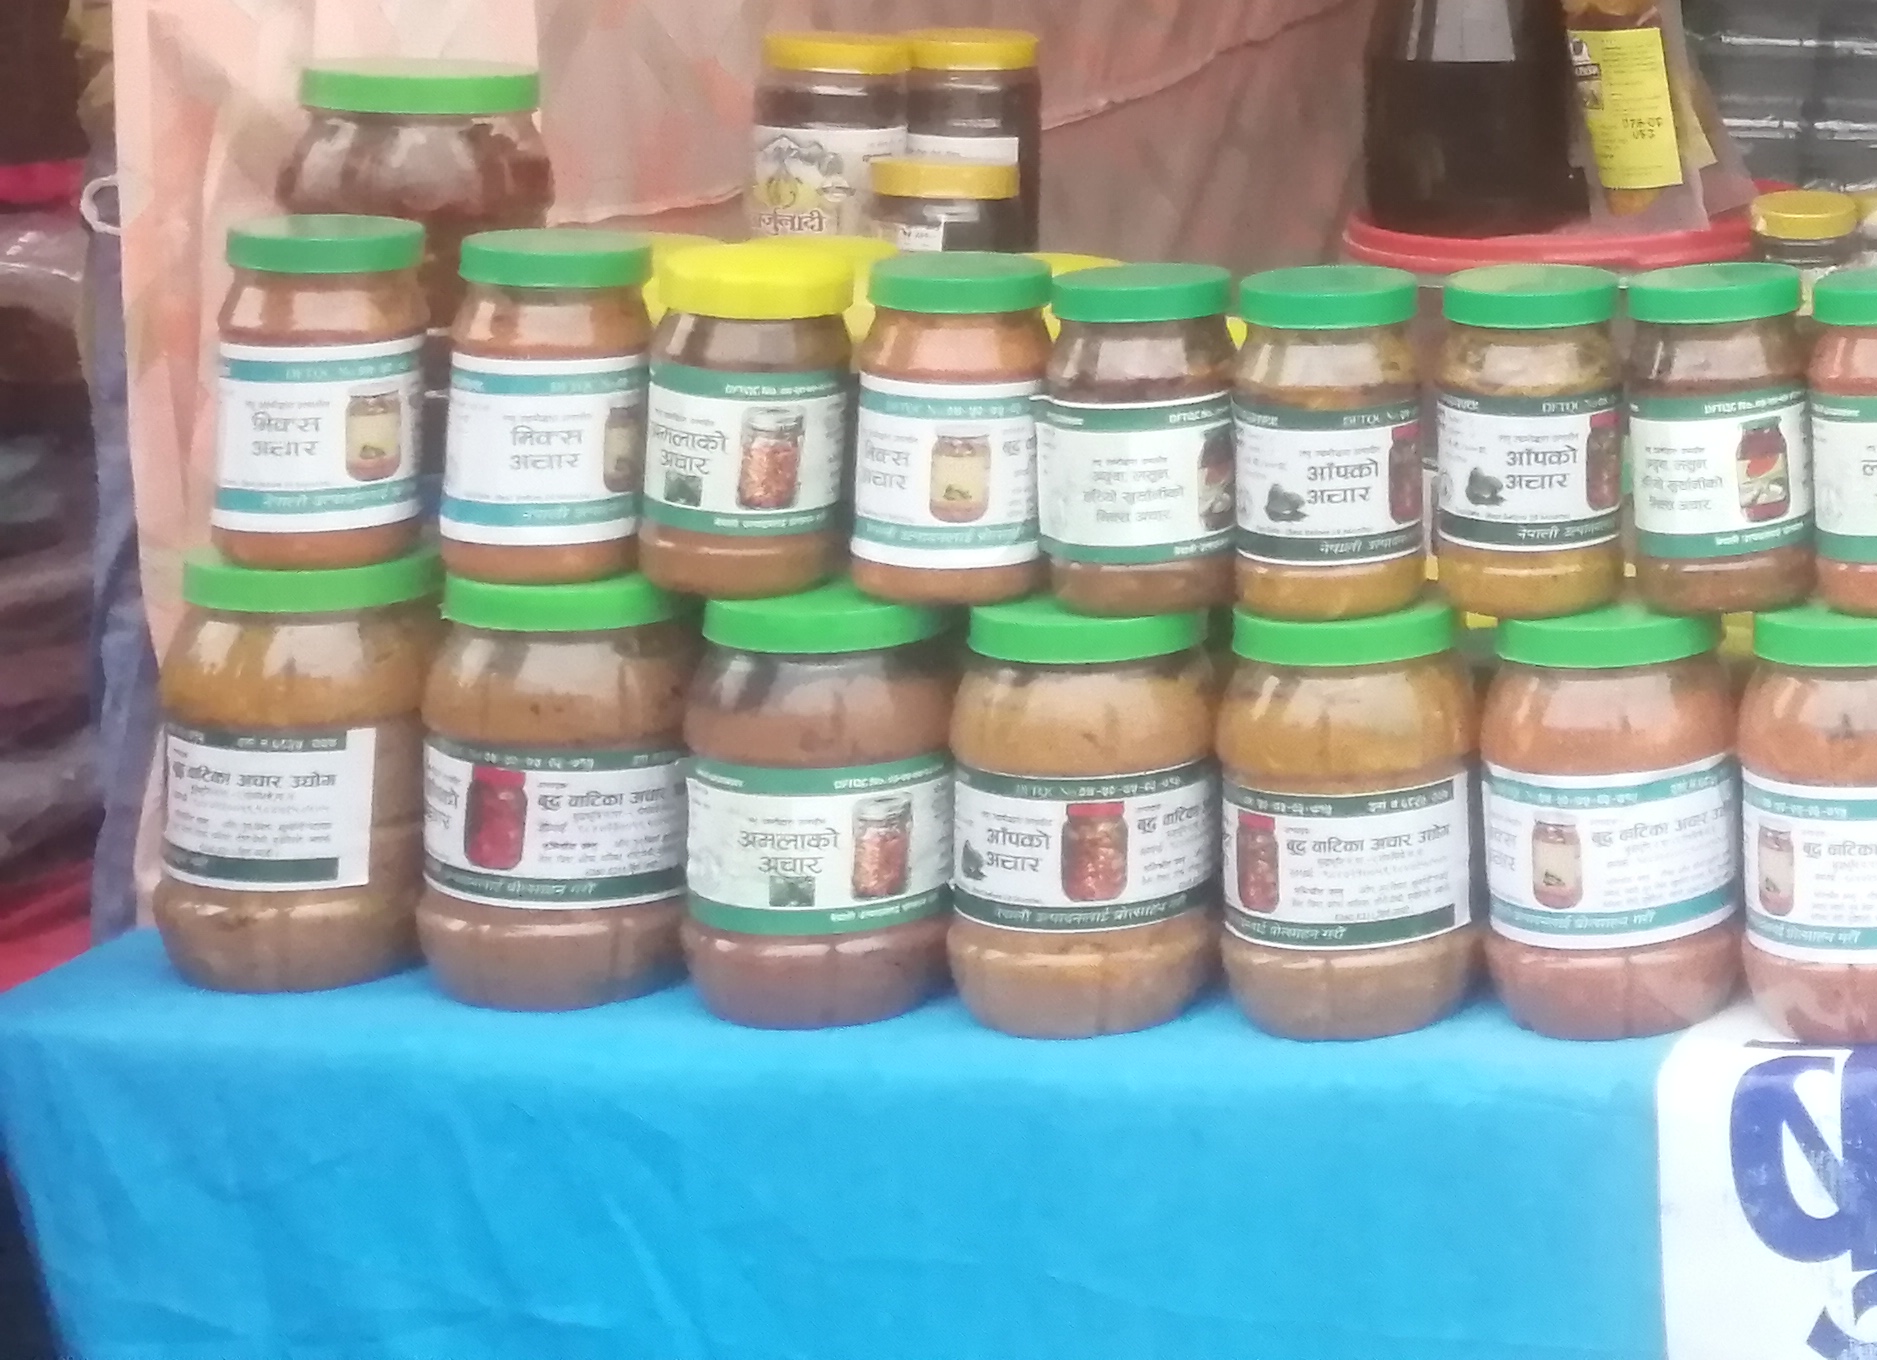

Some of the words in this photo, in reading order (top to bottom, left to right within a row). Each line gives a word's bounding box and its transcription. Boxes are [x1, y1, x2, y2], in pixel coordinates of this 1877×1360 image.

[510, 425, 584, 446] मिक्स
[251, 441, 319, 457] अचार
[1506, 445, 1579, 468] आँपको
[509, 453, 581, 472] अचार
[660, 449, 711, 475] अचार
[1505, 472, 1571, 490] अचार
[1306, 486, 1372, 504] अचार
[737, 827, 842, 852] अमलाको
[986, 827, 1051, 850] आँपको
[1369, 833, 1412, 850] अचार
[758, 855, 824, 877] अचार
[986, 851, 1041, 873] अचार
